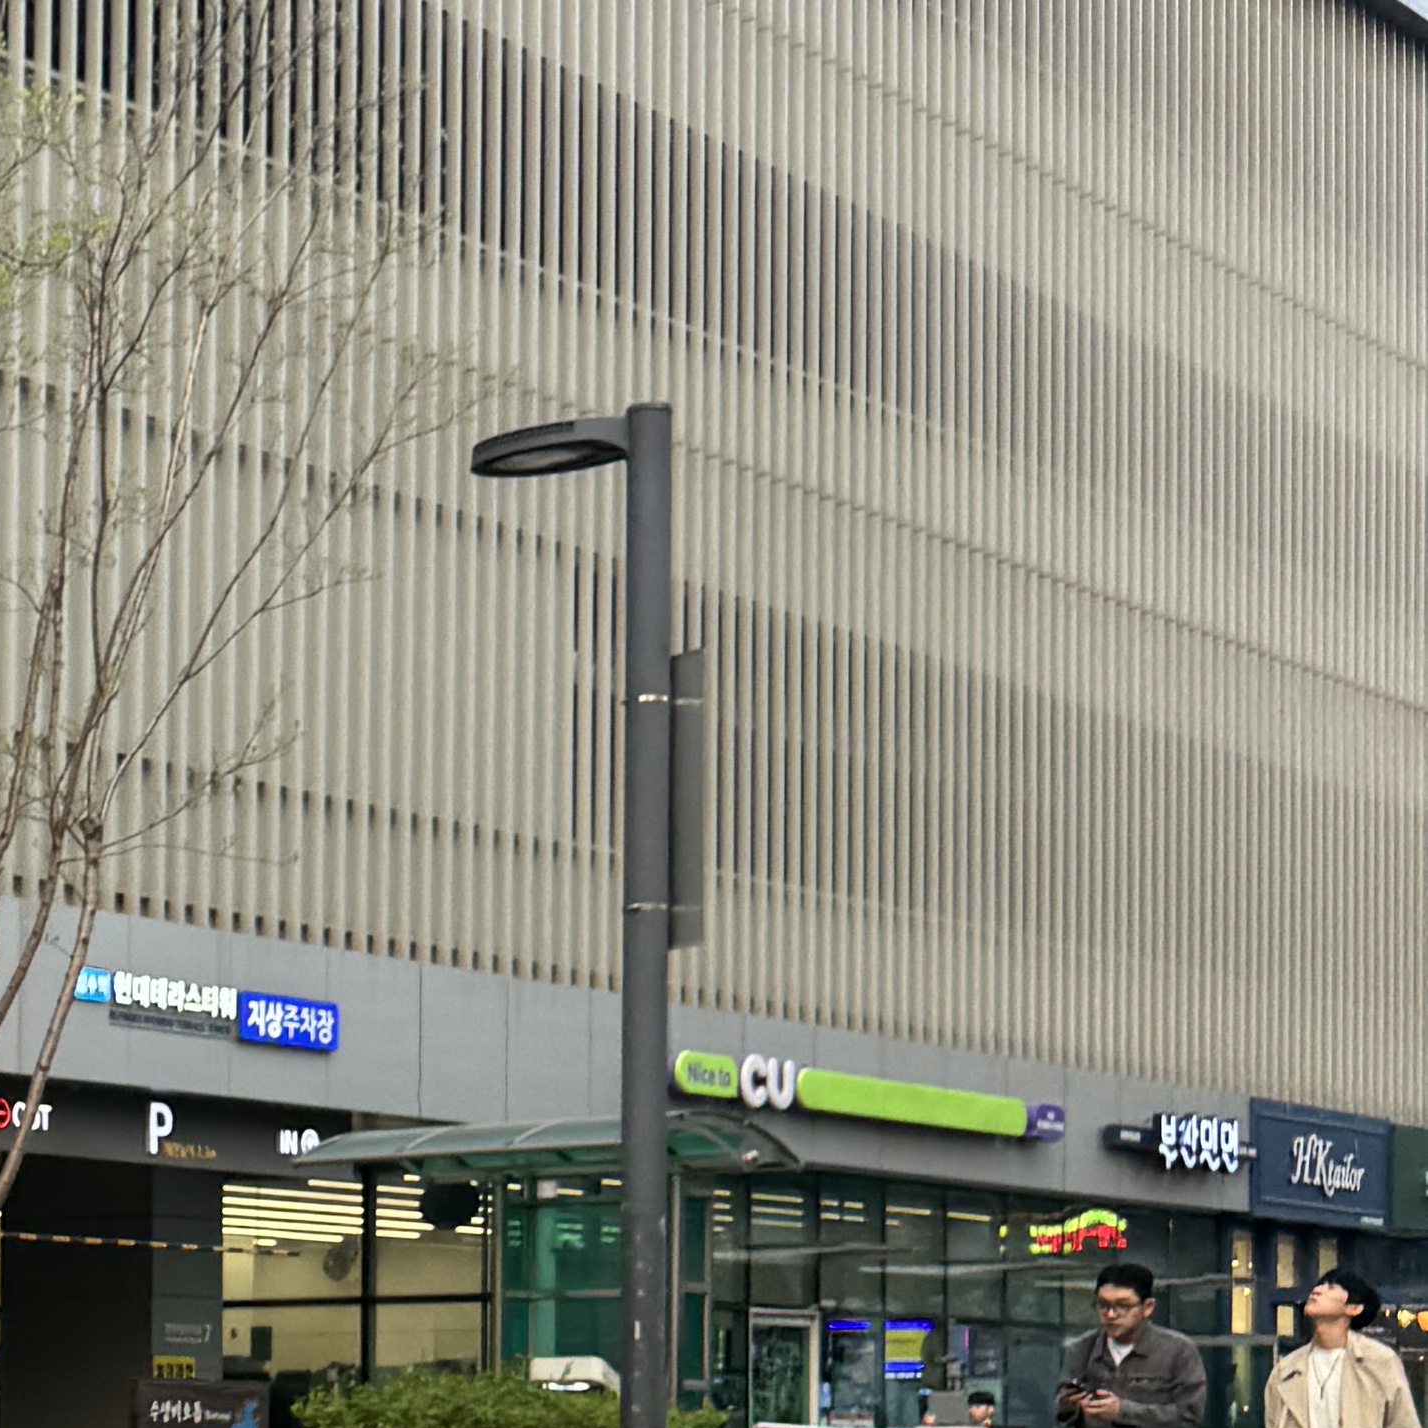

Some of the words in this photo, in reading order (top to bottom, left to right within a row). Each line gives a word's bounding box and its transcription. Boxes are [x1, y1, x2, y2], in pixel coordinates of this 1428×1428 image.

[247, 1000, 335, 1044] 지상주차장
[687, 1062, 716, 1085] Nice
[718, 1068, 731, 1087] to
[740, 1053, 795, 1111] CU
[149, 1101, 174, 1155] P
[279, 1129, 299, 1156] IN
